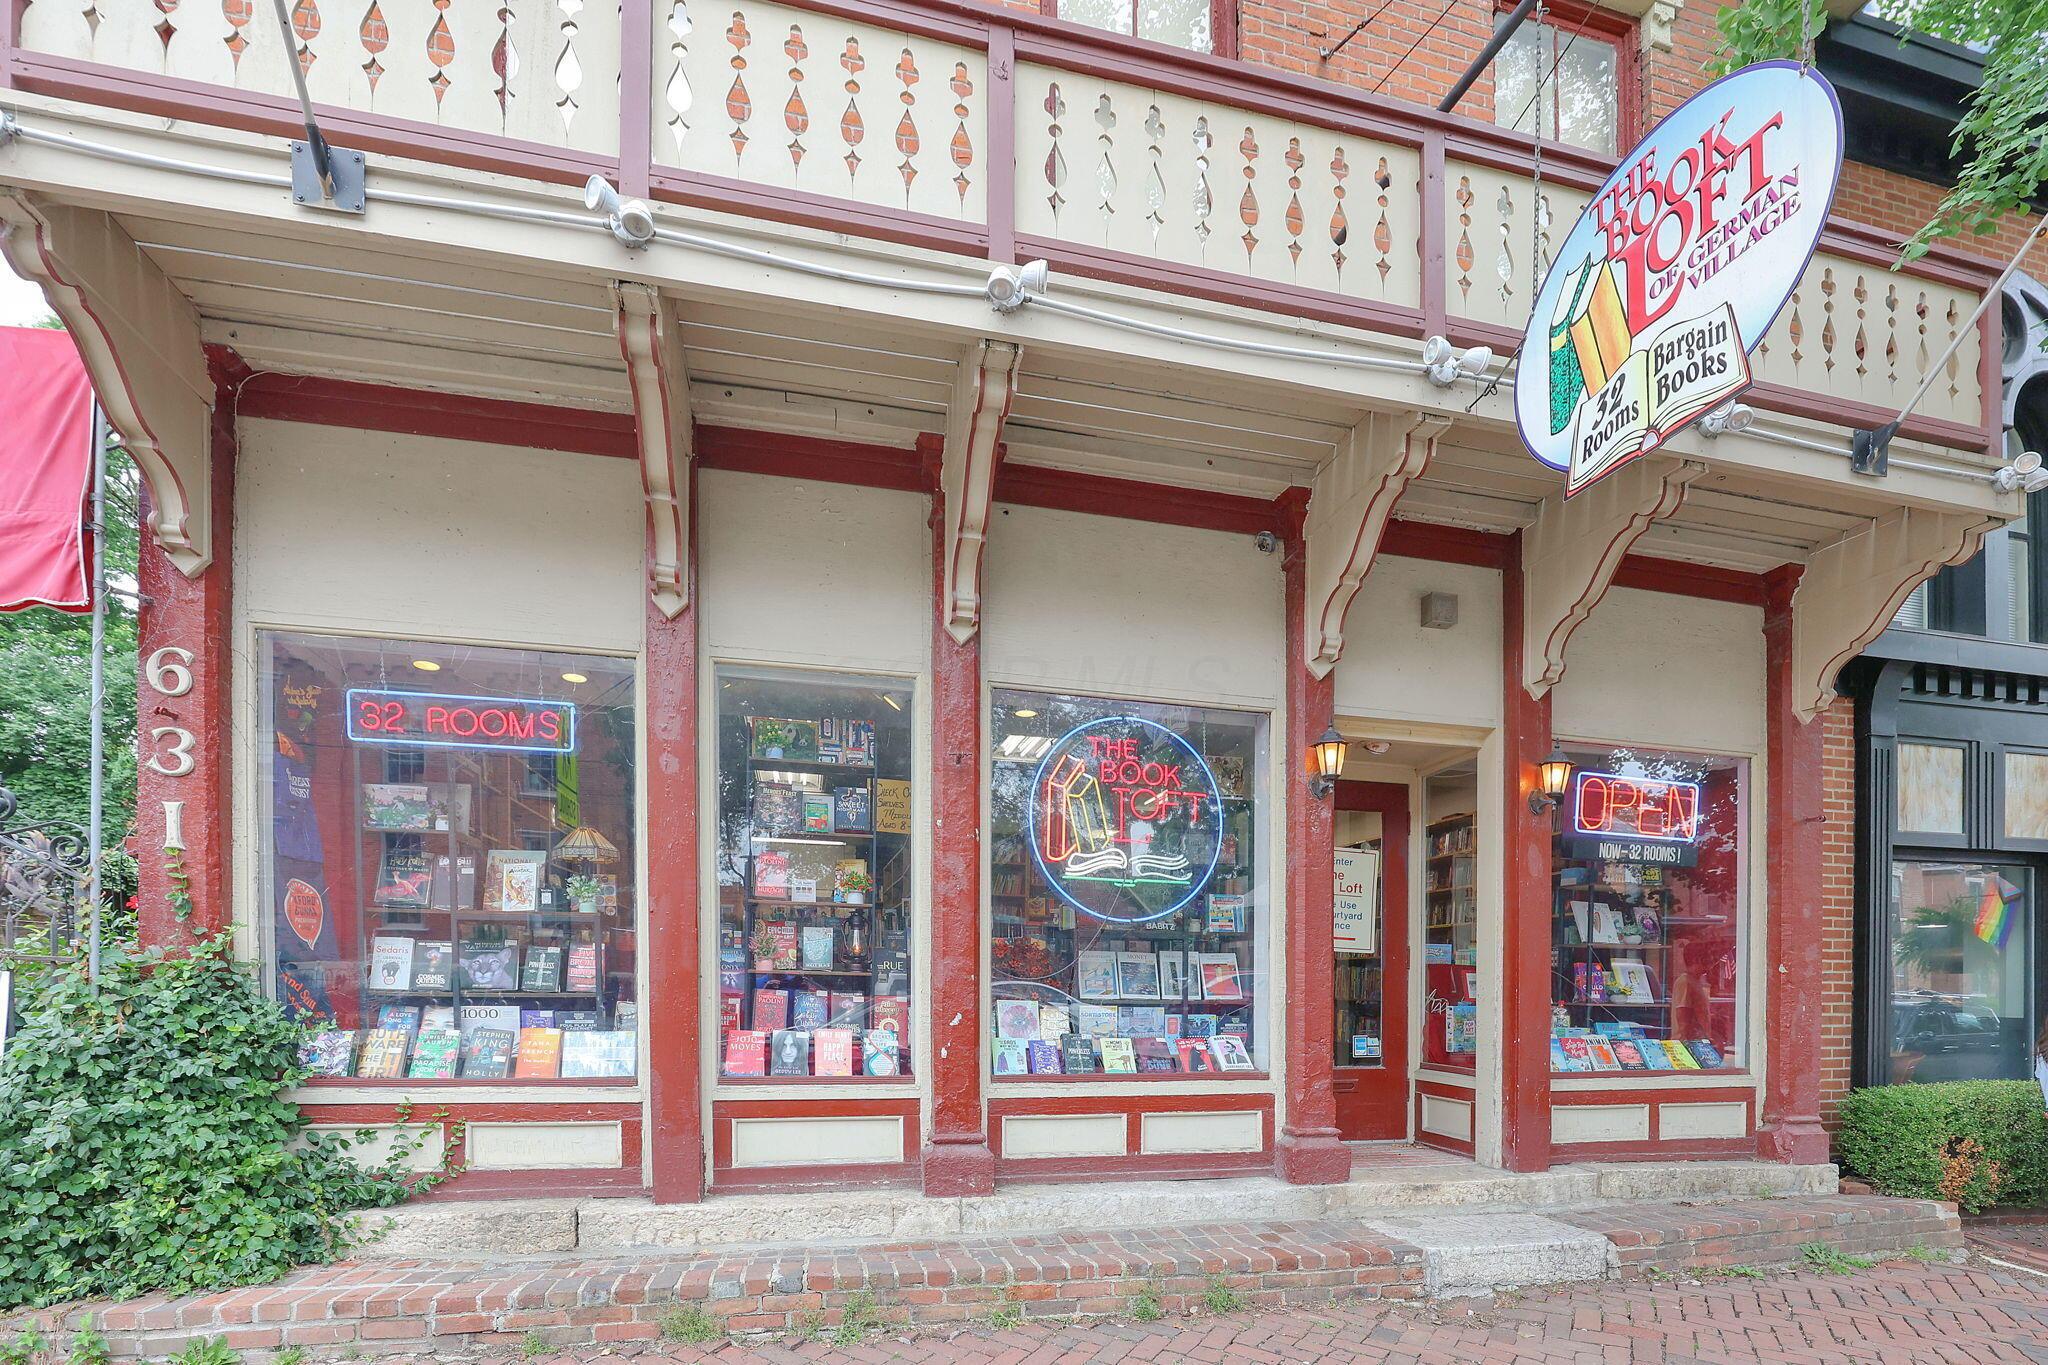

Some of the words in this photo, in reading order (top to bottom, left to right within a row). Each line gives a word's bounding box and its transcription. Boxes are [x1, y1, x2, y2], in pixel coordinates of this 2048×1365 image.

[1589, 146, 1658, 236] THE
[1602, 106, 1737, 262] BOOK
[1616, 111, 1783, 338] LOFT
[1649, 263, 1679, 299] OF
[1688, 163, 1800, 270] GERMAN
[1687, 191, 1801, 290] VILLAGE
[1653, 320, 1728, 377] Bargain
[1656, 350, 1728, 409] Books
[1592, 373, 1626, 431] 32
[1581, 400, 1640, 464] Rooms
[359, 702, 405, 732] 32
[427, 706, 561, 740] ROOMS
[1087, 736, 1138, 761] THE
[1101, 760, 1182, 788] BOOK
[838, 801, 865, 809] SWEET
[1580, 777, 1697, 838] OPEN
[1110, 787, 1208, 844] LOFT
[1339, 882, 1363, 894] Loft
[1340, 901, 1357, 910] Use
[376, 945, 410, 954] Sedaris
[883, 961, 904, 970] RUE
[461, 1008, 499, 1019] 1000
[474, 1038, 508, 1049] KING
[476, 1030, 511, 1039] STEPHEN
[736, 1035, 758, 1043] JOJO
[364, 1041, 405, 1049] WARE
[730, 1043, 761, 1051] MOYES
[822, 1042, 845, 1052] HAPPY
[822, 1051, 845, 1061] PLACE
[466, 1069, 500, 1077] HOLLY
